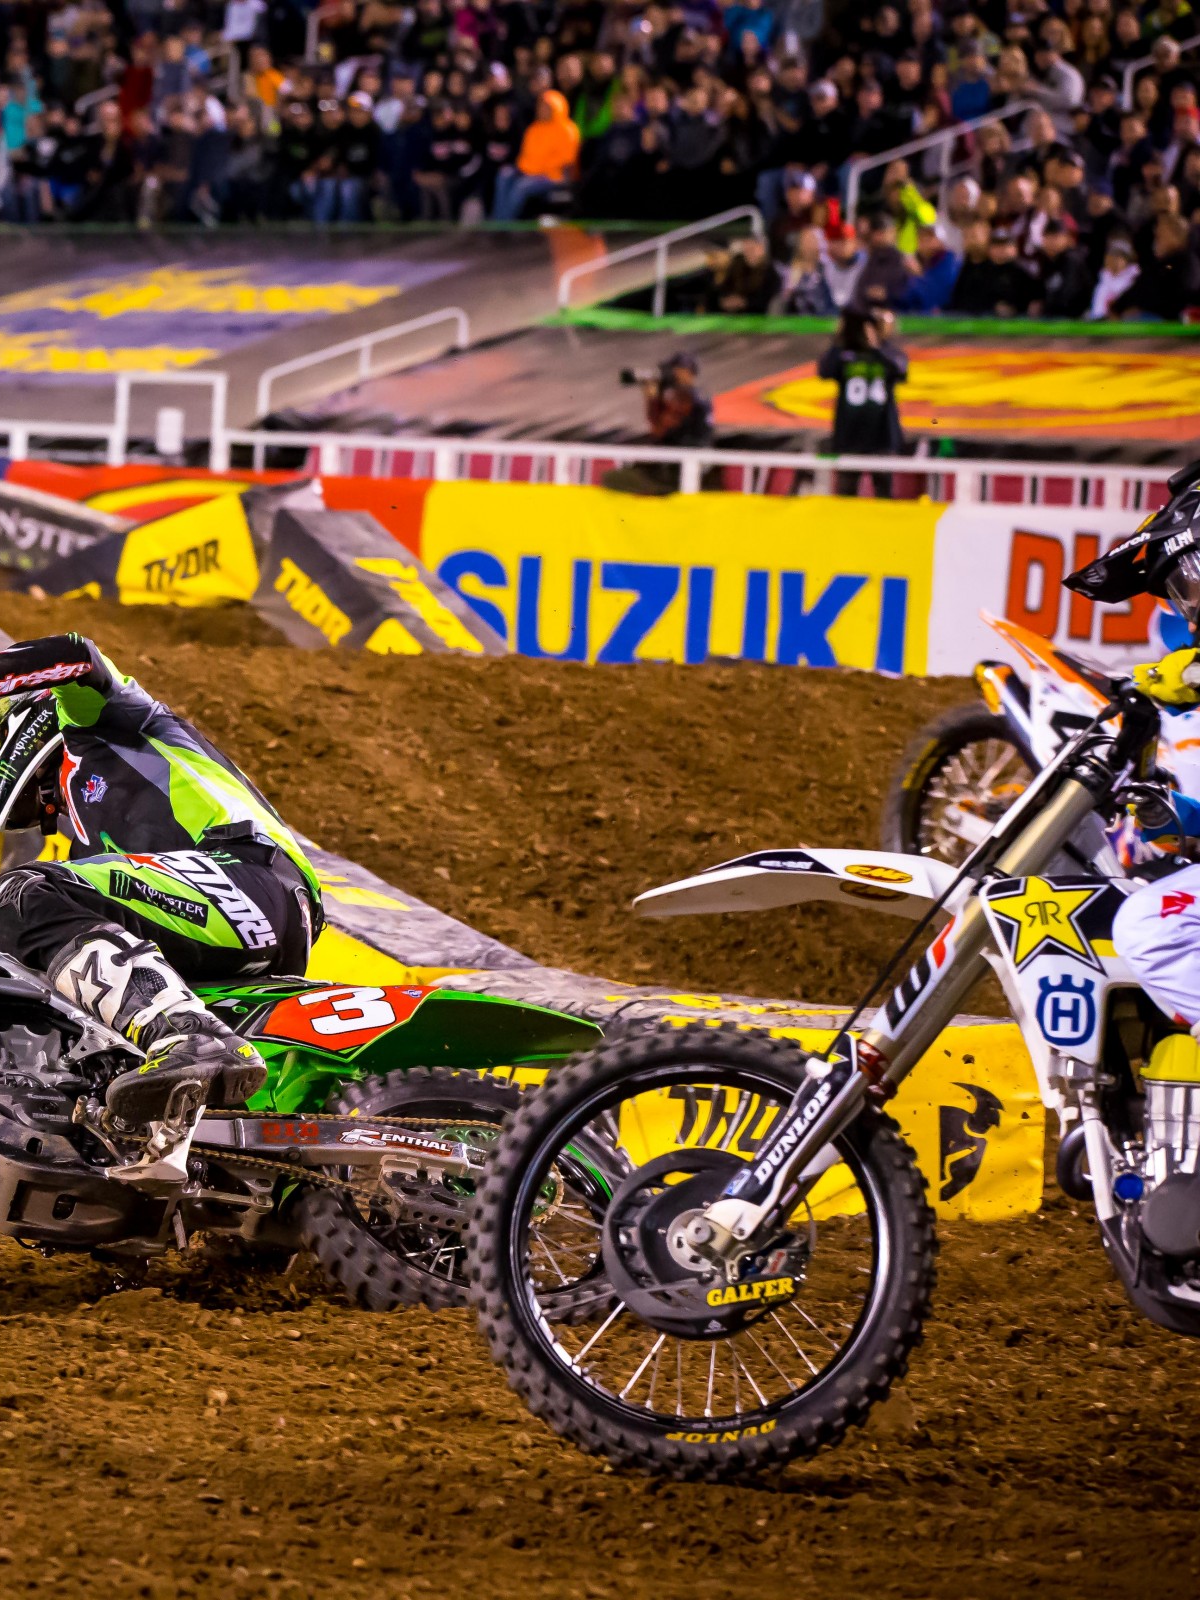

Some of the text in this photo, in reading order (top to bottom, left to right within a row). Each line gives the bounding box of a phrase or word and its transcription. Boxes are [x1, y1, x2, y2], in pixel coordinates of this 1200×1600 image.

[436, 549, 909, 675] SUZUKI
[9, 709, 53, 762] MONSTER
[23, 720, 52, 757] ENERGY
[298, 986, 397, 1035] 3
[753, 1082, 832, 1186] DUNLOP
[706, 1277, 796, 1307] GALFER
[665, 1419, 777, 1444] DUNLOP
